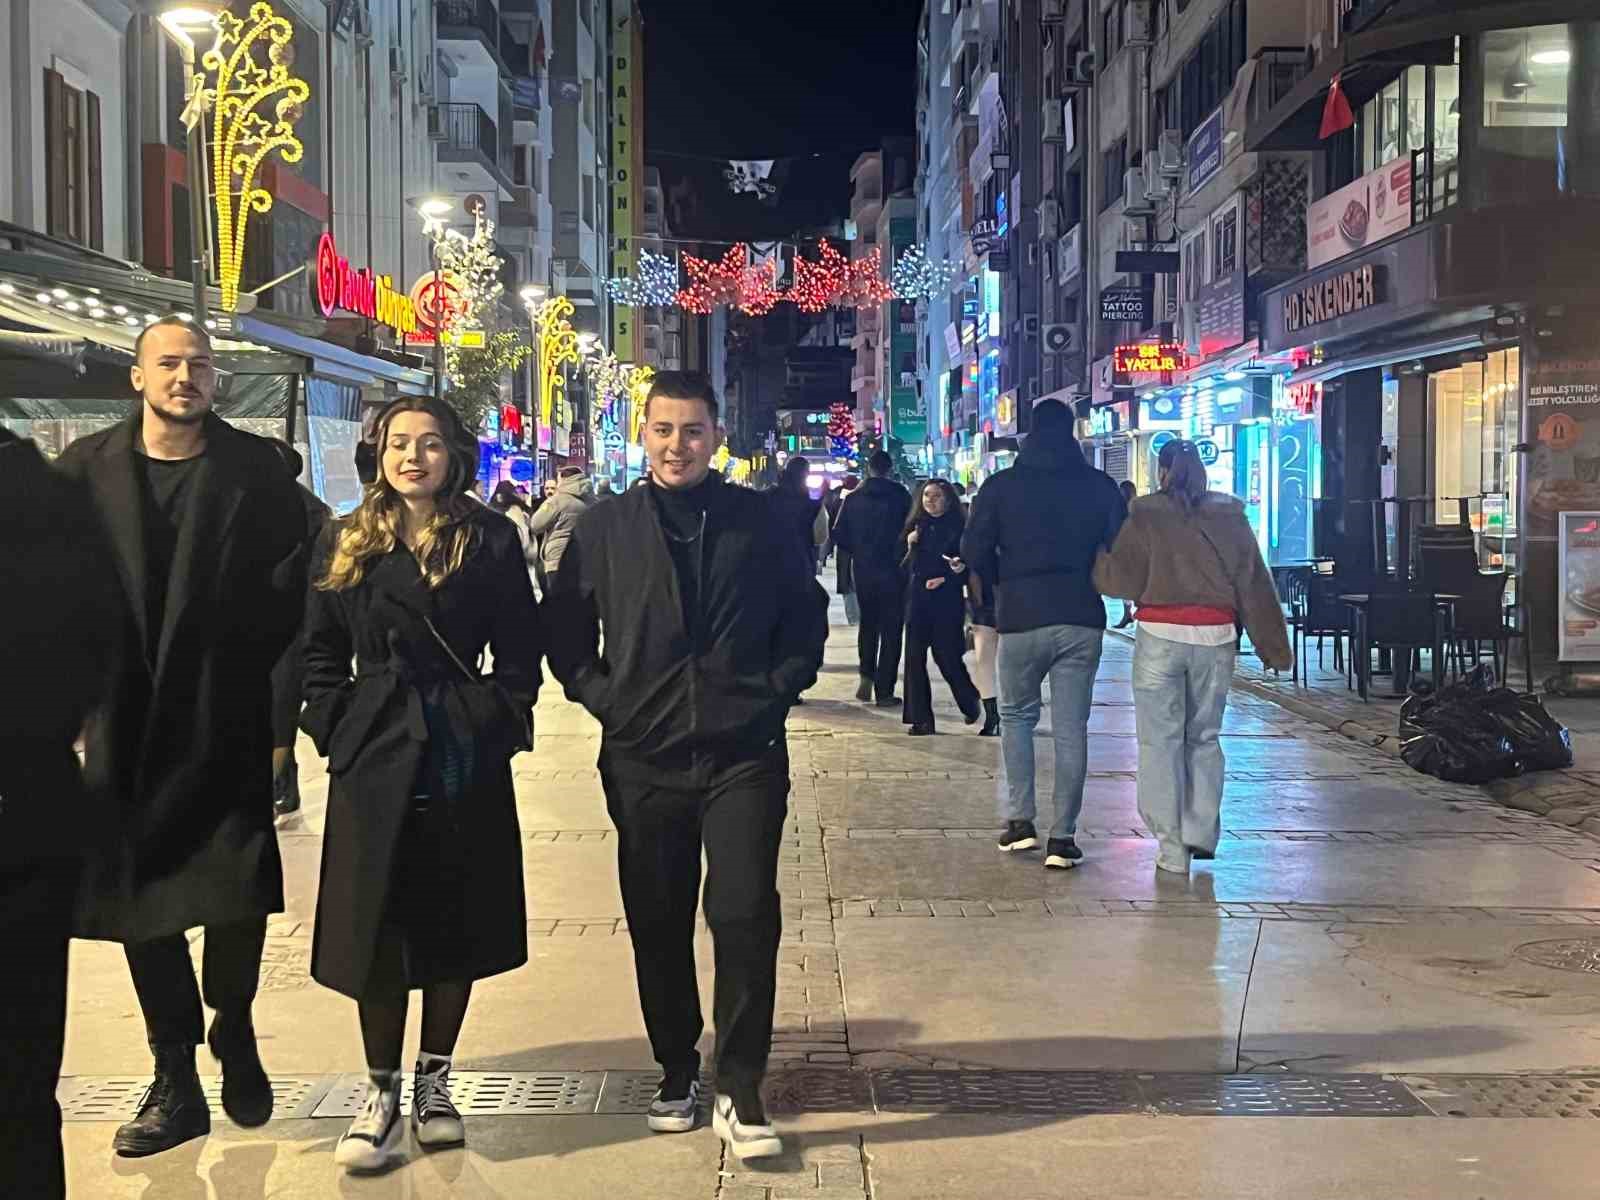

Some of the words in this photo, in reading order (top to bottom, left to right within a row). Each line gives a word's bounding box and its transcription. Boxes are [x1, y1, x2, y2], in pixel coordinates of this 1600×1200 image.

[1103, 302, 1143, 311] TATTOO
[1102, 311, 1144, 320] PIERCING
[1124, 358, 1176, 370] YAPILIR
[1551, 393, 1600, 405] YOLCULUĞ
